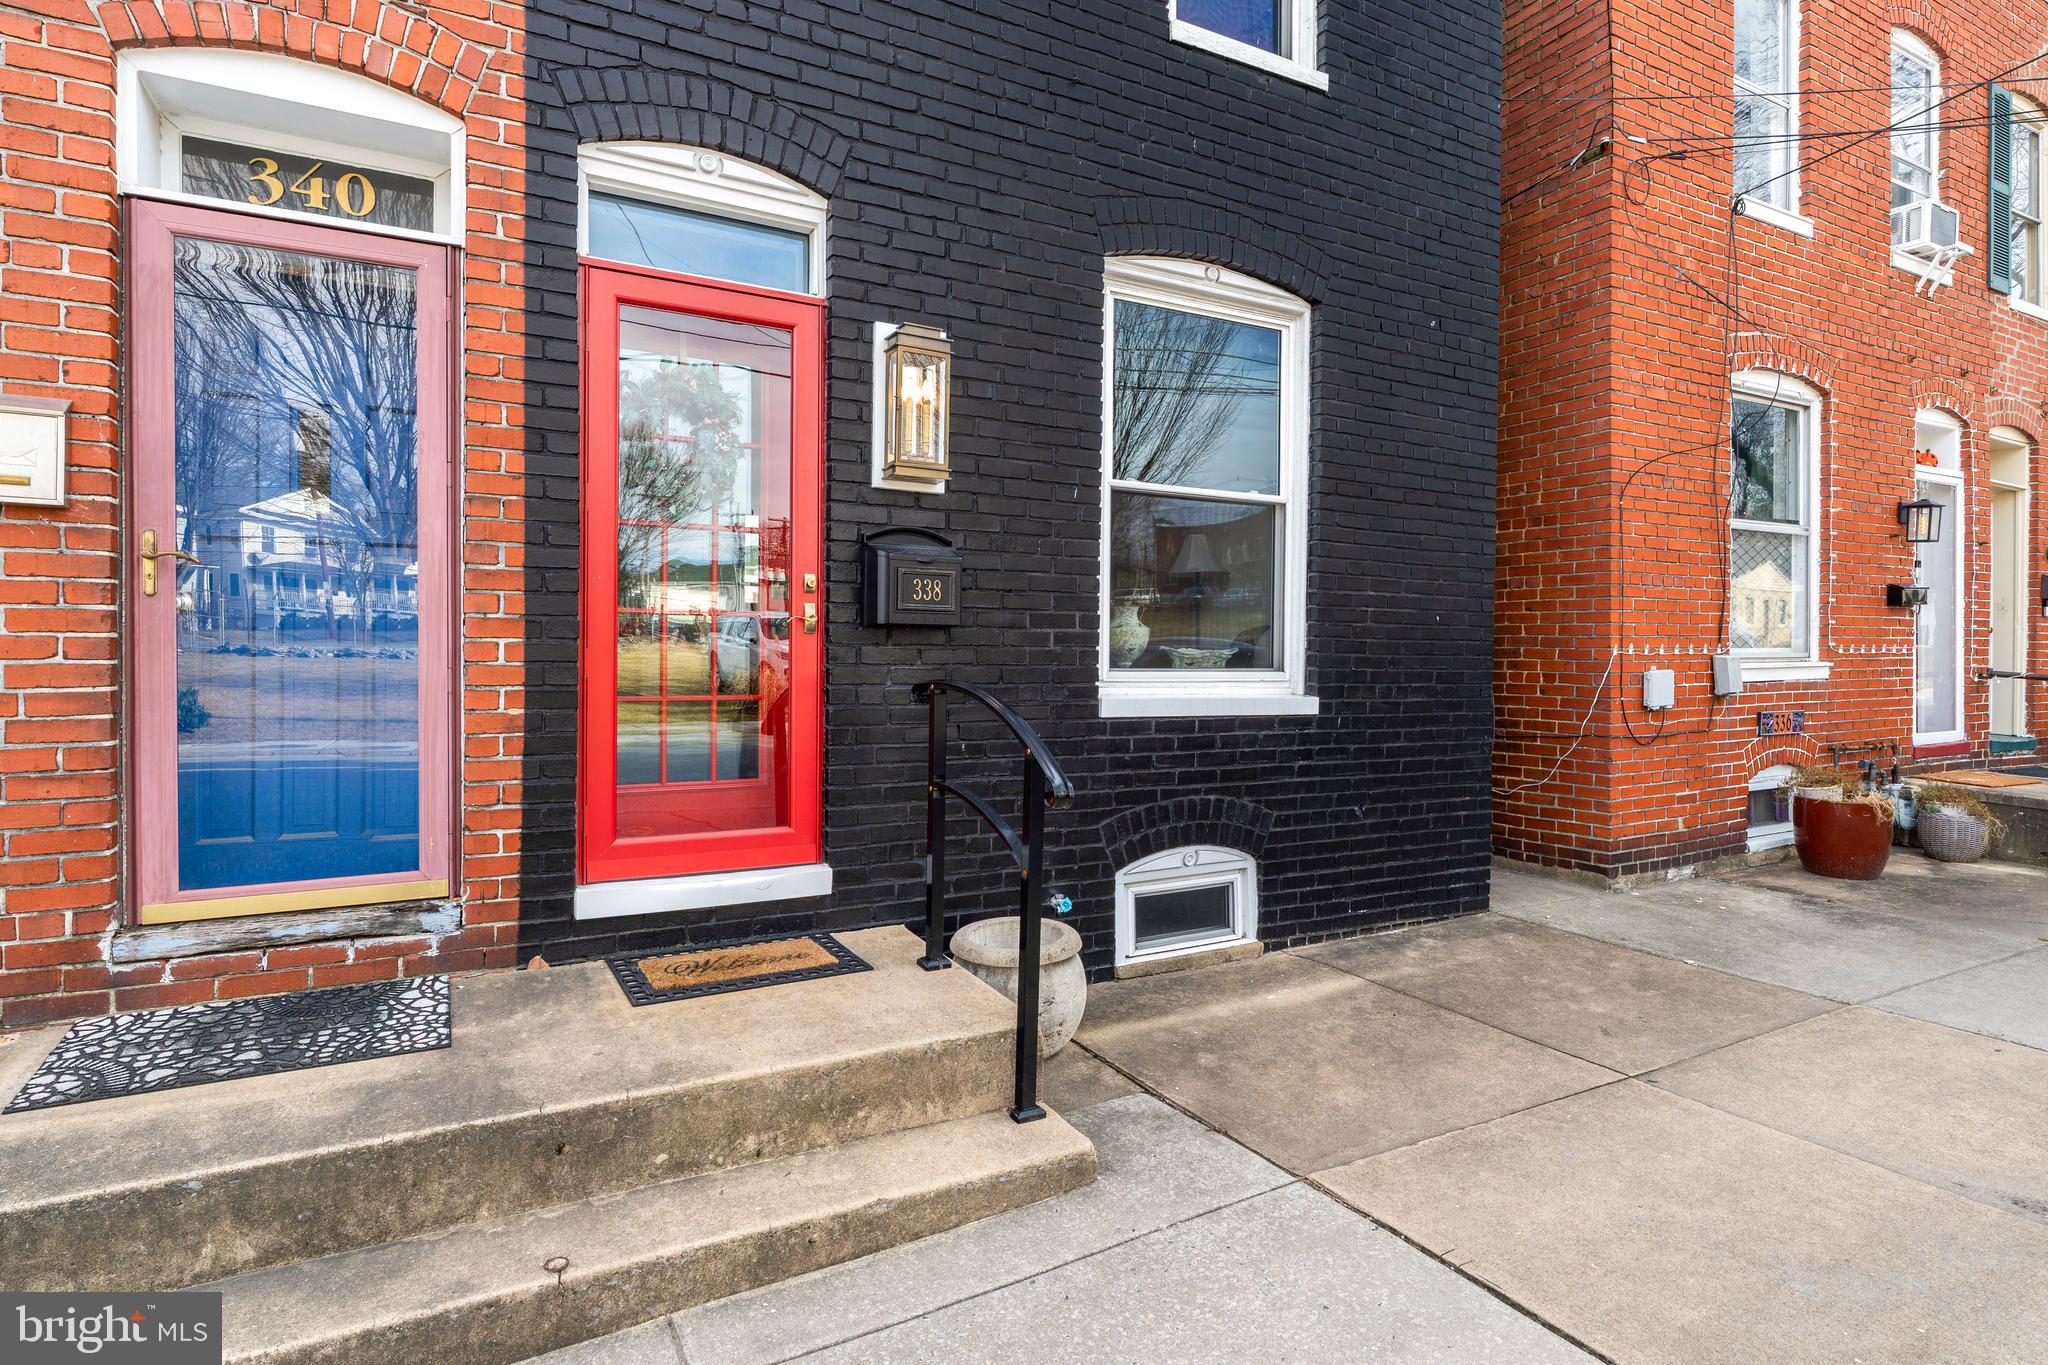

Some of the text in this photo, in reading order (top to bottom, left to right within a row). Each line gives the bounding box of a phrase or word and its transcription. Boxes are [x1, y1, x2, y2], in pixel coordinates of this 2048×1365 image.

[248, 157, 377, 217] 340
[913, 578, 942, 601] 338
[1774, 713, 1792, 733] 336
